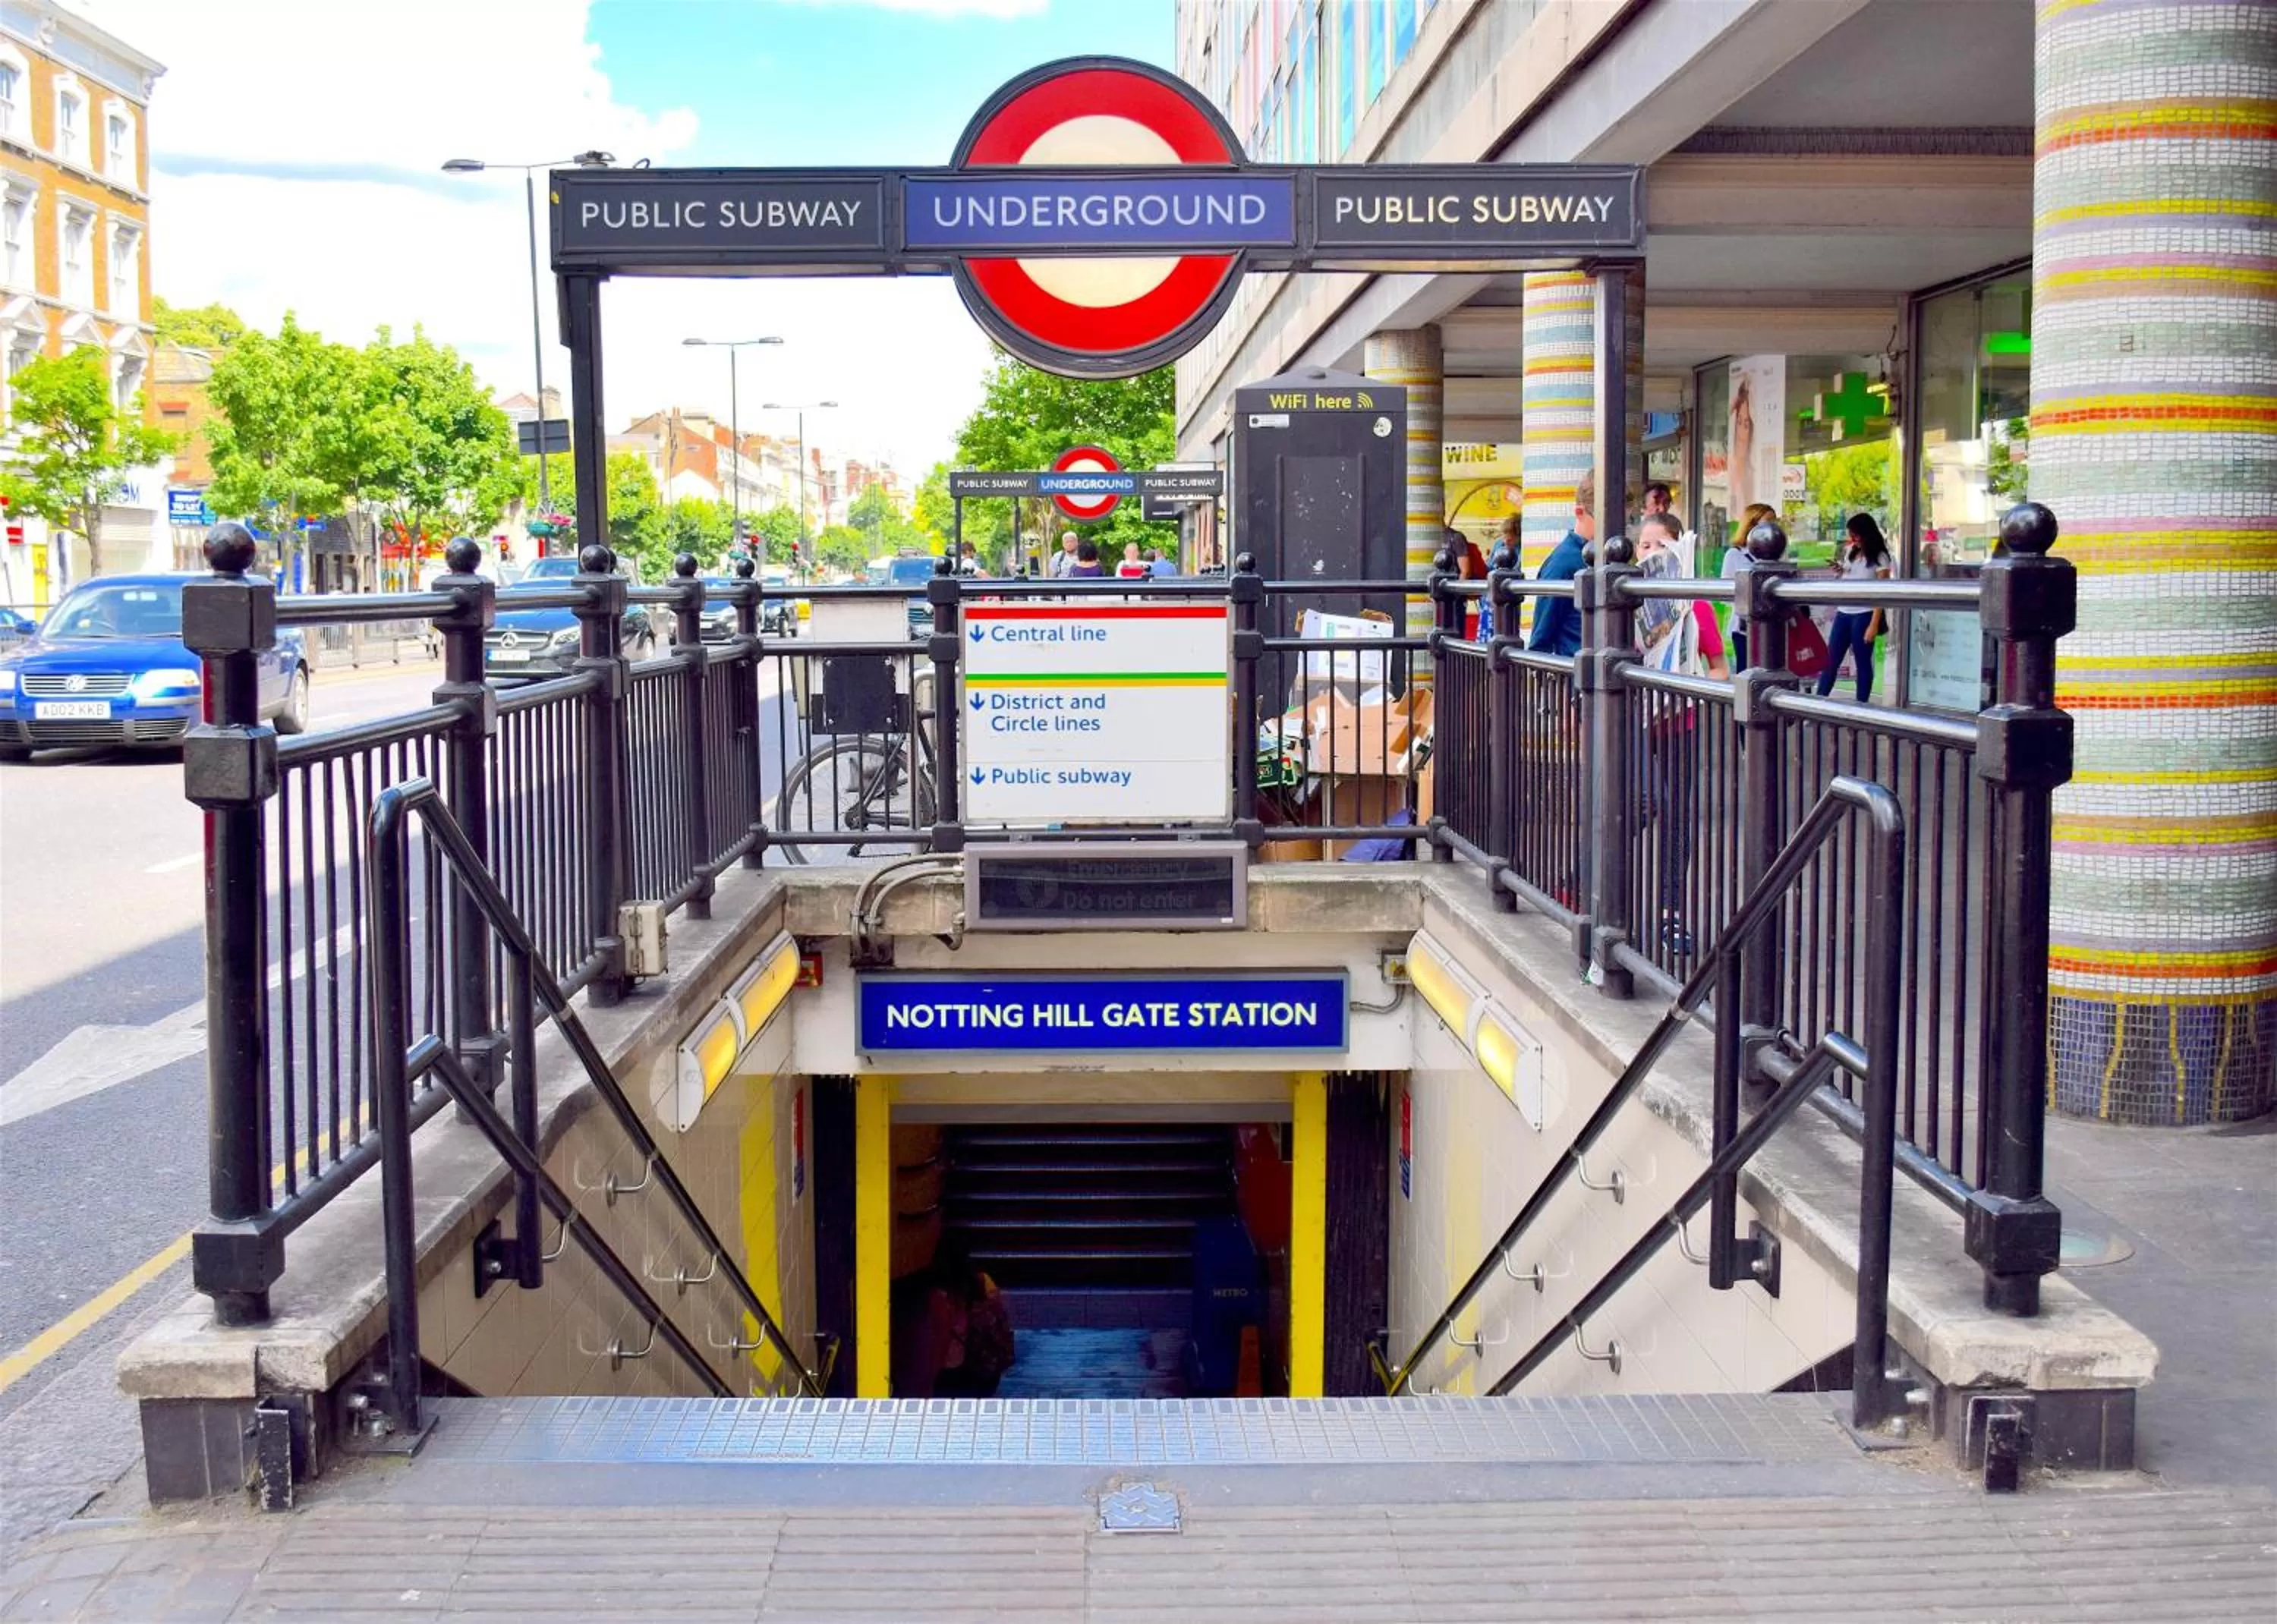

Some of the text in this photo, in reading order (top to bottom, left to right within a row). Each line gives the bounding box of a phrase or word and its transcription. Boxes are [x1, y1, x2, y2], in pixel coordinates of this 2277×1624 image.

[581, 200, 862, 228] PUBLIC SUBWAY
[934, 194, 1267, 228] UNDERGROUND
[1335, 194, 1614, 224] PUBLIC SUBWAY
[1269, 392, 1353, 410] WiFi here
[1444, 444, 1498, 464] WINE
[957, 478, 1028, 489] PUBLIC SUBWAY
[1041, 478, 1134, 490] UNDERGROUND
[1145, 477, 1217, 488] PUBLIC SUBWAY
[990, 624, 1107, 643] Central line
[78, 703, 106, 716] KKB
[990, 692, 1107, 710] District and
[990, 714, 1101, 732] Circle lines
[991, 767, 1132, 788] Public subway
[1064, 891, 1093, 911] Do
[1098, 889, 1137, 911] not
[887, 1001, 1318, 1029] NOTTING HILL GATE STATION
